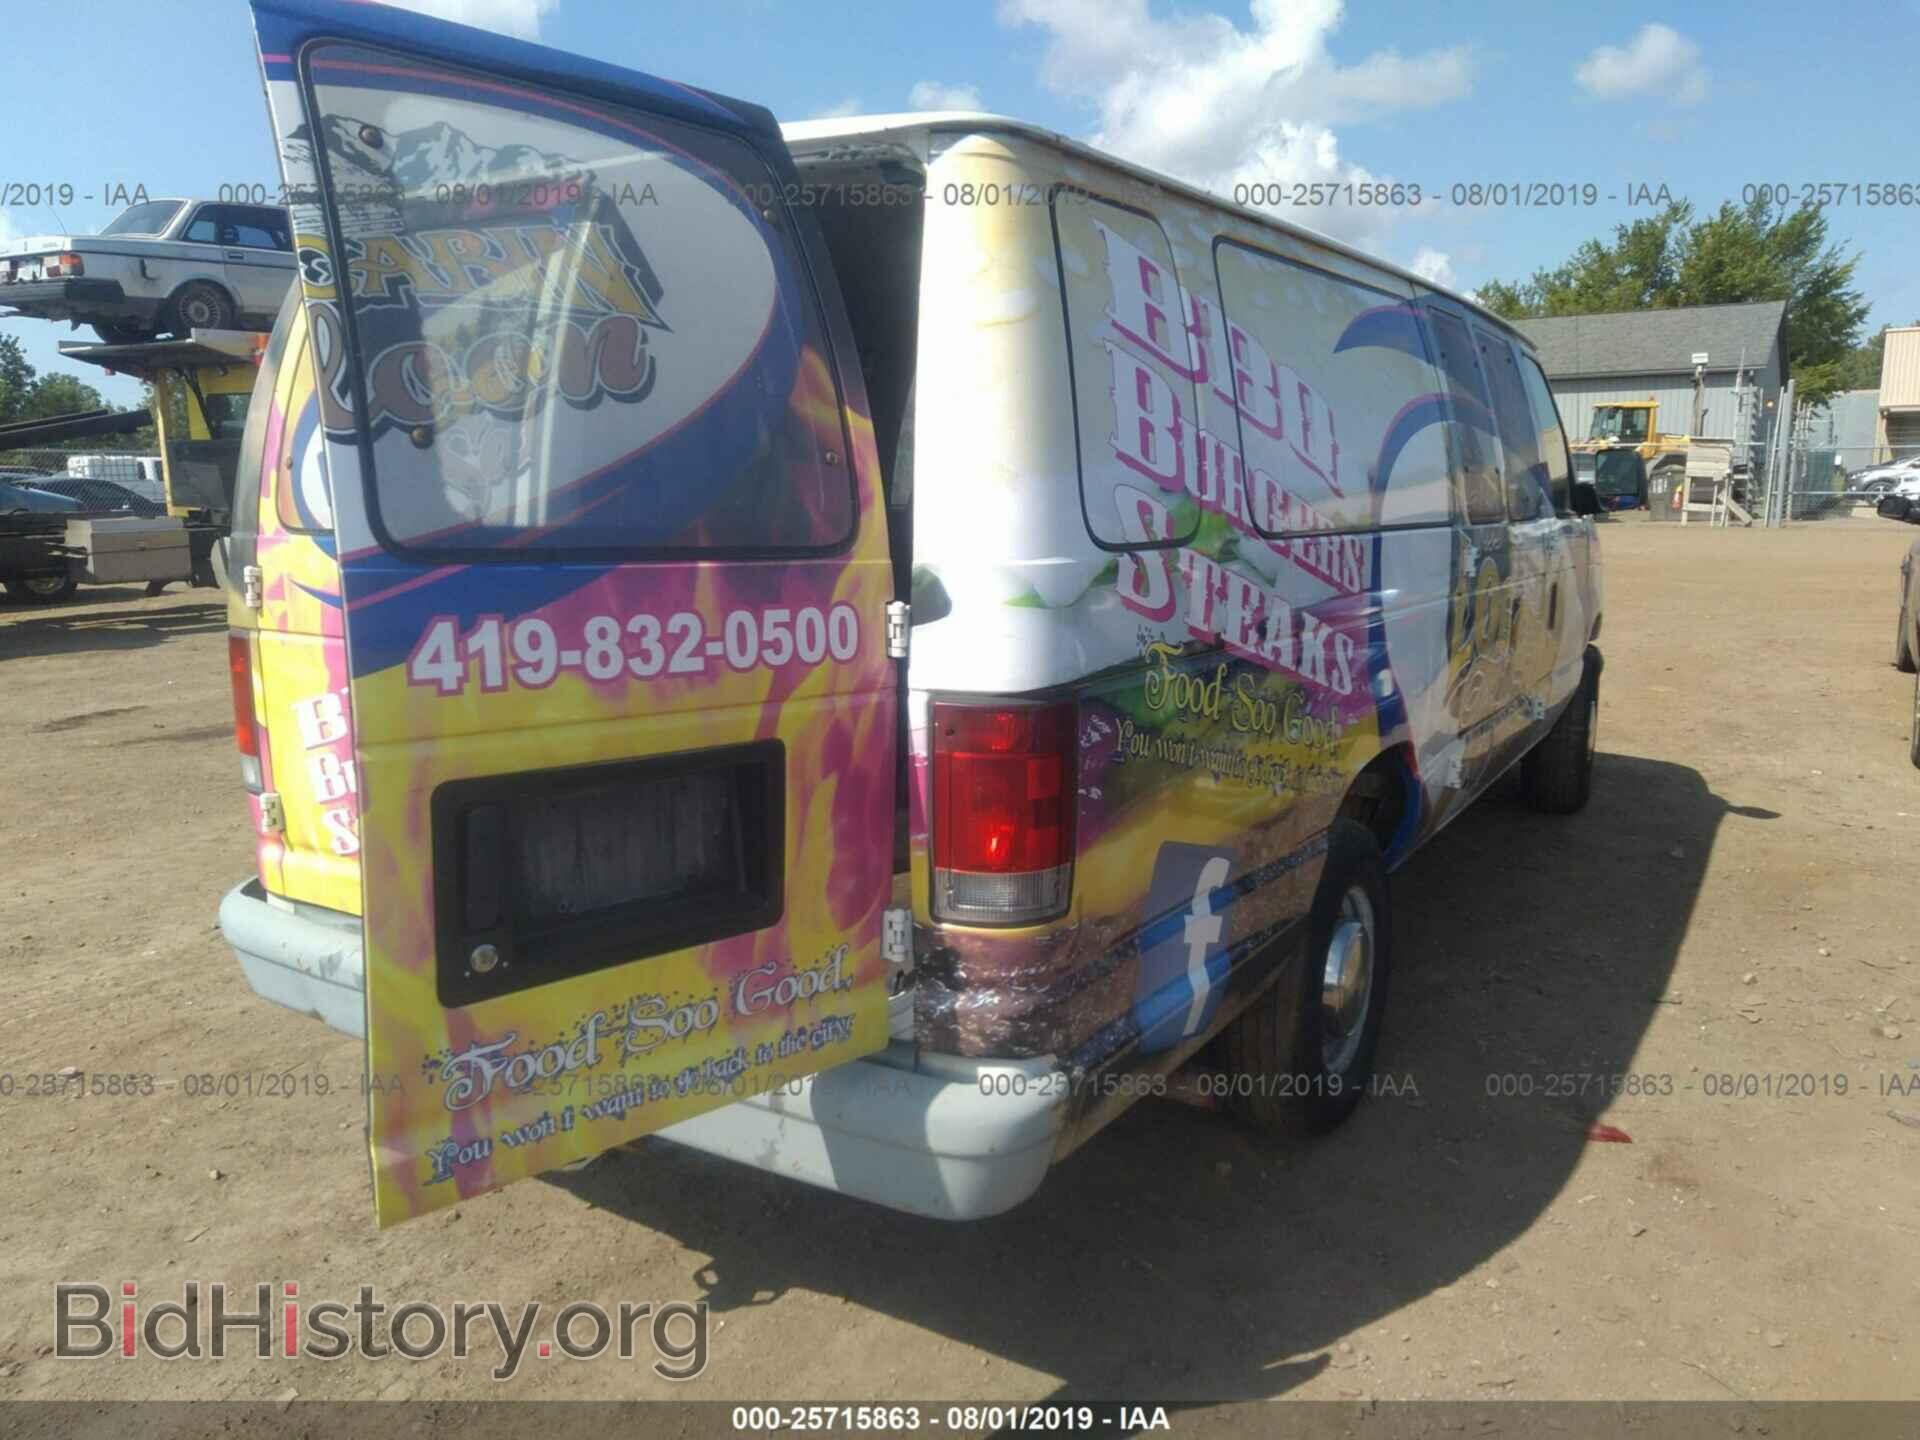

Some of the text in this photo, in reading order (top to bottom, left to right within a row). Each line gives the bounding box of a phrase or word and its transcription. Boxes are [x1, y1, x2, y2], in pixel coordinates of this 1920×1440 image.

[1094, 217, 1346, 499] BBQ
[1103, 339, 1367, 595] BURGERS
[411, 603, 859, 692] 419-832-0500
[1112, 484, 1355, 696] STEAKS
[1115, 718, 1149, 757] You
[1144, 641, 1228, 721] Food
[1232, 673, 1276, 733] Soo
[426, 1138, 494, 1182] You
[580, 1083, 645, 1121] want
[649, 1076, 672, 1102] to
[674, 1064, 702, 1097] go
[702, 1046, 750, 1083] back
[754, 1038, 774, 1065] to
[778, 1025, 808, 1054] the
[442, 1010, 608, 1111] Food
[623, 994, 721, 1053] Soo
